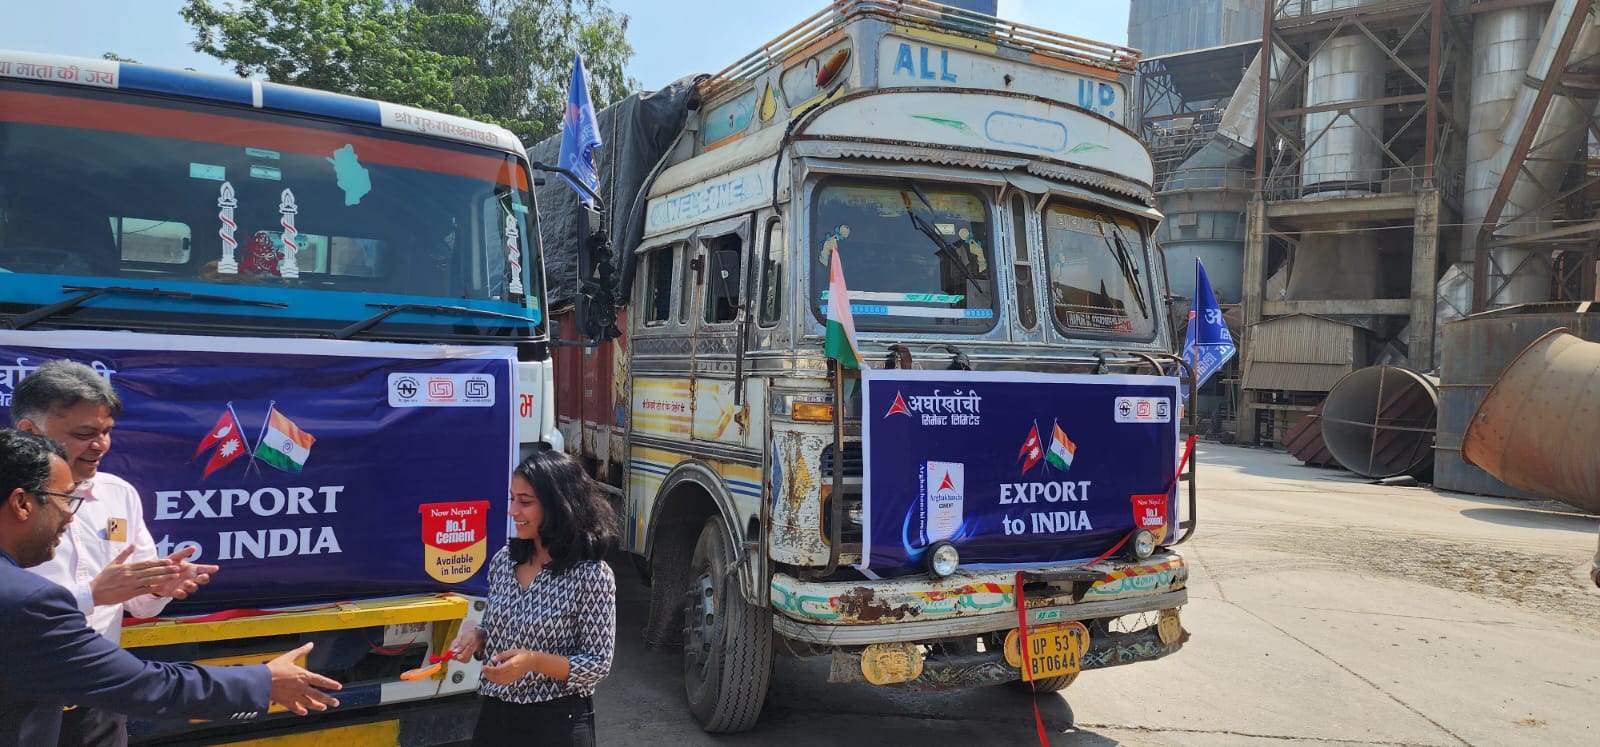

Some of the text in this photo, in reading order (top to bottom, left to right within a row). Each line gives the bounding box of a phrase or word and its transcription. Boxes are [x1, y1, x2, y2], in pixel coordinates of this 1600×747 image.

[16, 63, 53, 79] माता
[57, 65, 80, 81] की
[83, 69, 115, 85] जय
[893, 43, 957, 83] ALL
[153, 485, 345, 521] EXPORT
[999, 480, 1091, 505] EXPORT
[431, 506, 478, 518] Now Nepal's
[1002, 510, 1093, 535] to INDIA
[436, 529, 475, 544] Cement
[446, 519, 466, 532] No.1
[217, 526, 343, 561] INDIA
[436, 554, 473, 566] Available
[451, 565, 471, 575] India
[1033, 634, 1070, 655] UP 53
[1031, 652, 1075, 674] BT0644
